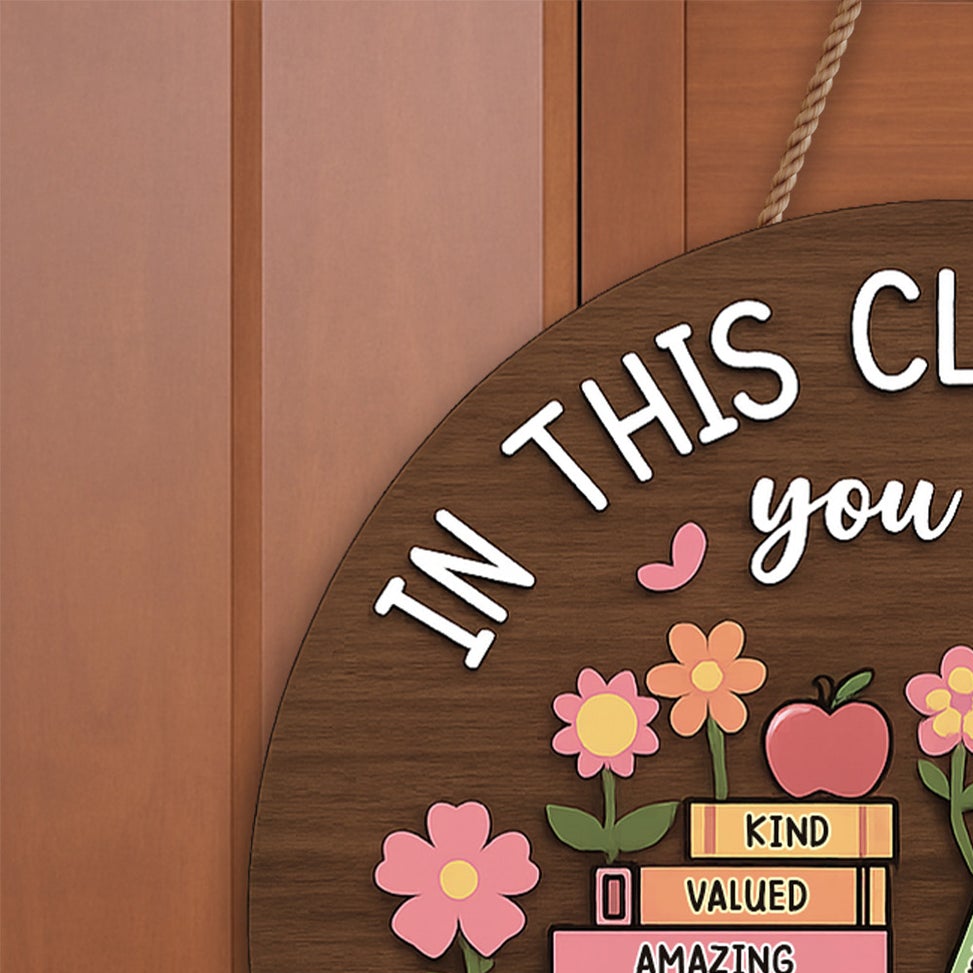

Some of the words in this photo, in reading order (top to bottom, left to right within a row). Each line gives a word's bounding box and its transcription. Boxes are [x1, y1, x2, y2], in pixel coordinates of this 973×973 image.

[374, 508, 536, 670] IN
[501, 300, 799, 511] THIS
[750, 476, 963, 585] you
[746, 814, 829, 848] KIND
[686, 878, 809, 913] VALUED
